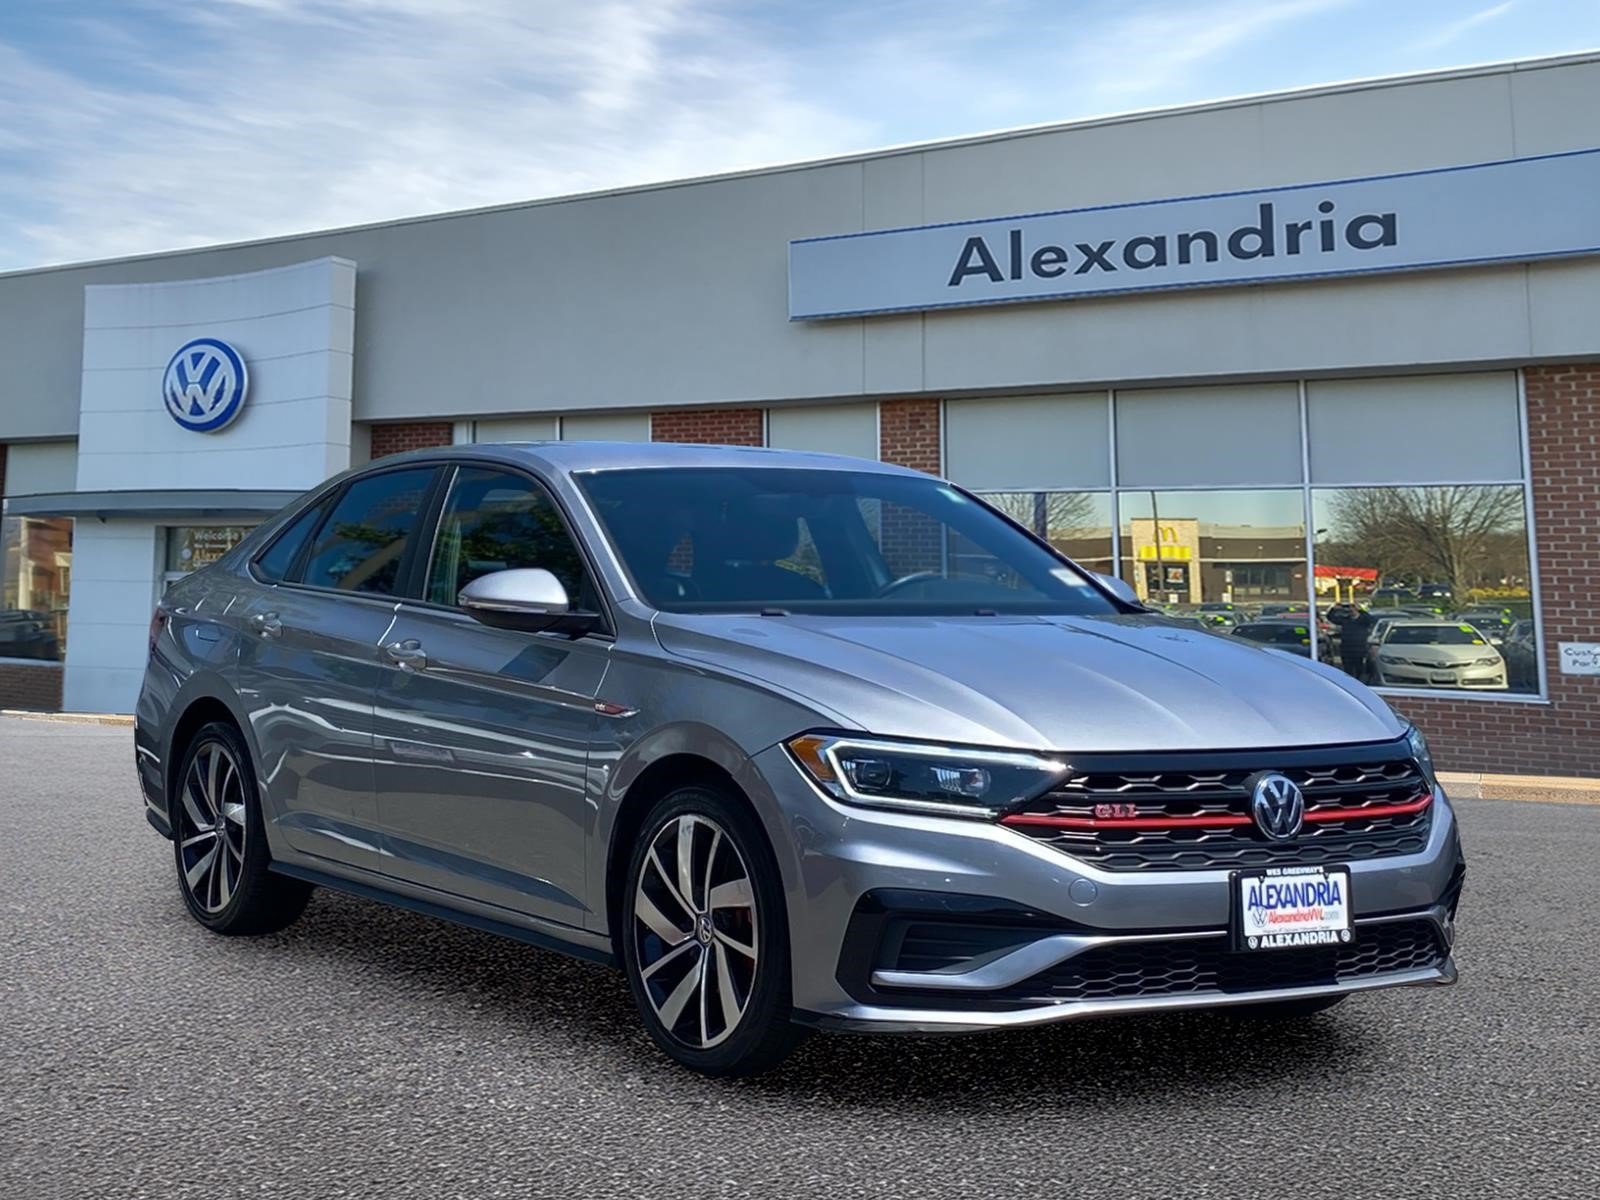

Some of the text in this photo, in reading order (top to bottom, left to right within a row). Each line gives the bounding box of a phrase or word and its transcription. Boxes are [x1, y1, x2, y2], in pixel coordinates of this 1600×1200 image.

[947, 201, 1397, 287] Alexandria
[166, 340, 241, 427] VW
[1095, 803, 1137, 818] GLI
[1247, 880, 1342, 911] ALEXANDRIA
[1260, 930, 1339, 949] ALEXANDRIA
